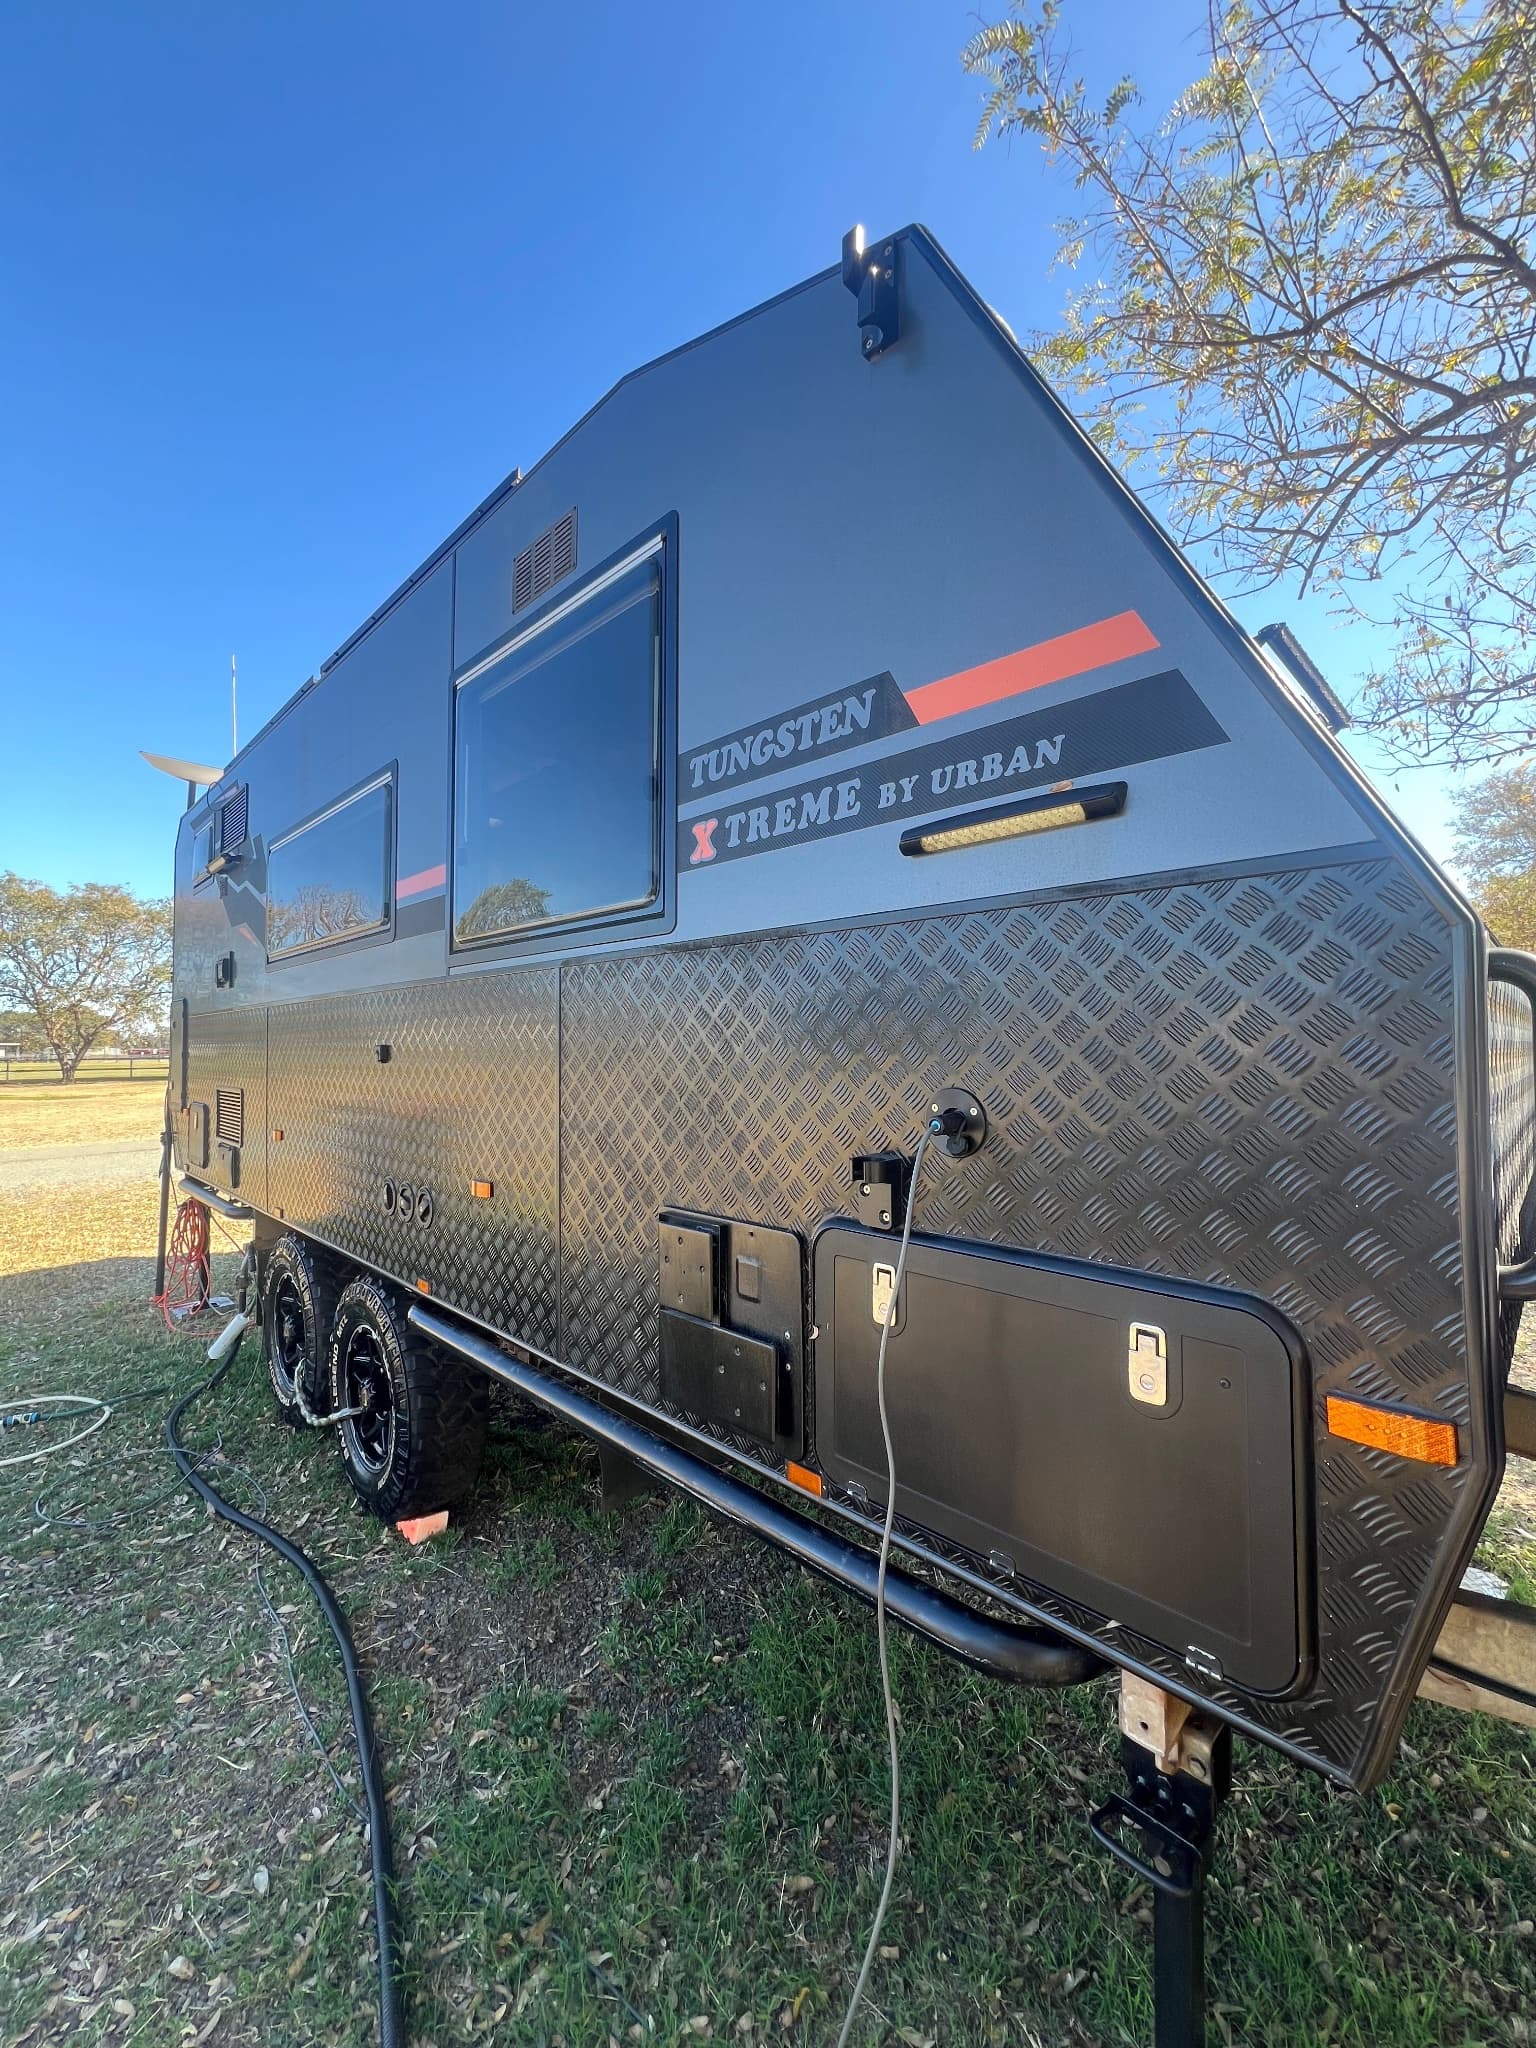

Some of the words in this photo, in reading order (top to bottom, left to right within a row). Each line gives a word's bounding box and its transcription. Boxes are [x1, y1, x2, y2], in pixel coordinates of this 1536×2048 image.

[689, 688, 876, 788] TUNGSTEN
[877, 774, 919, 809] BY
[930, 734, 1066, 794] URBAN
